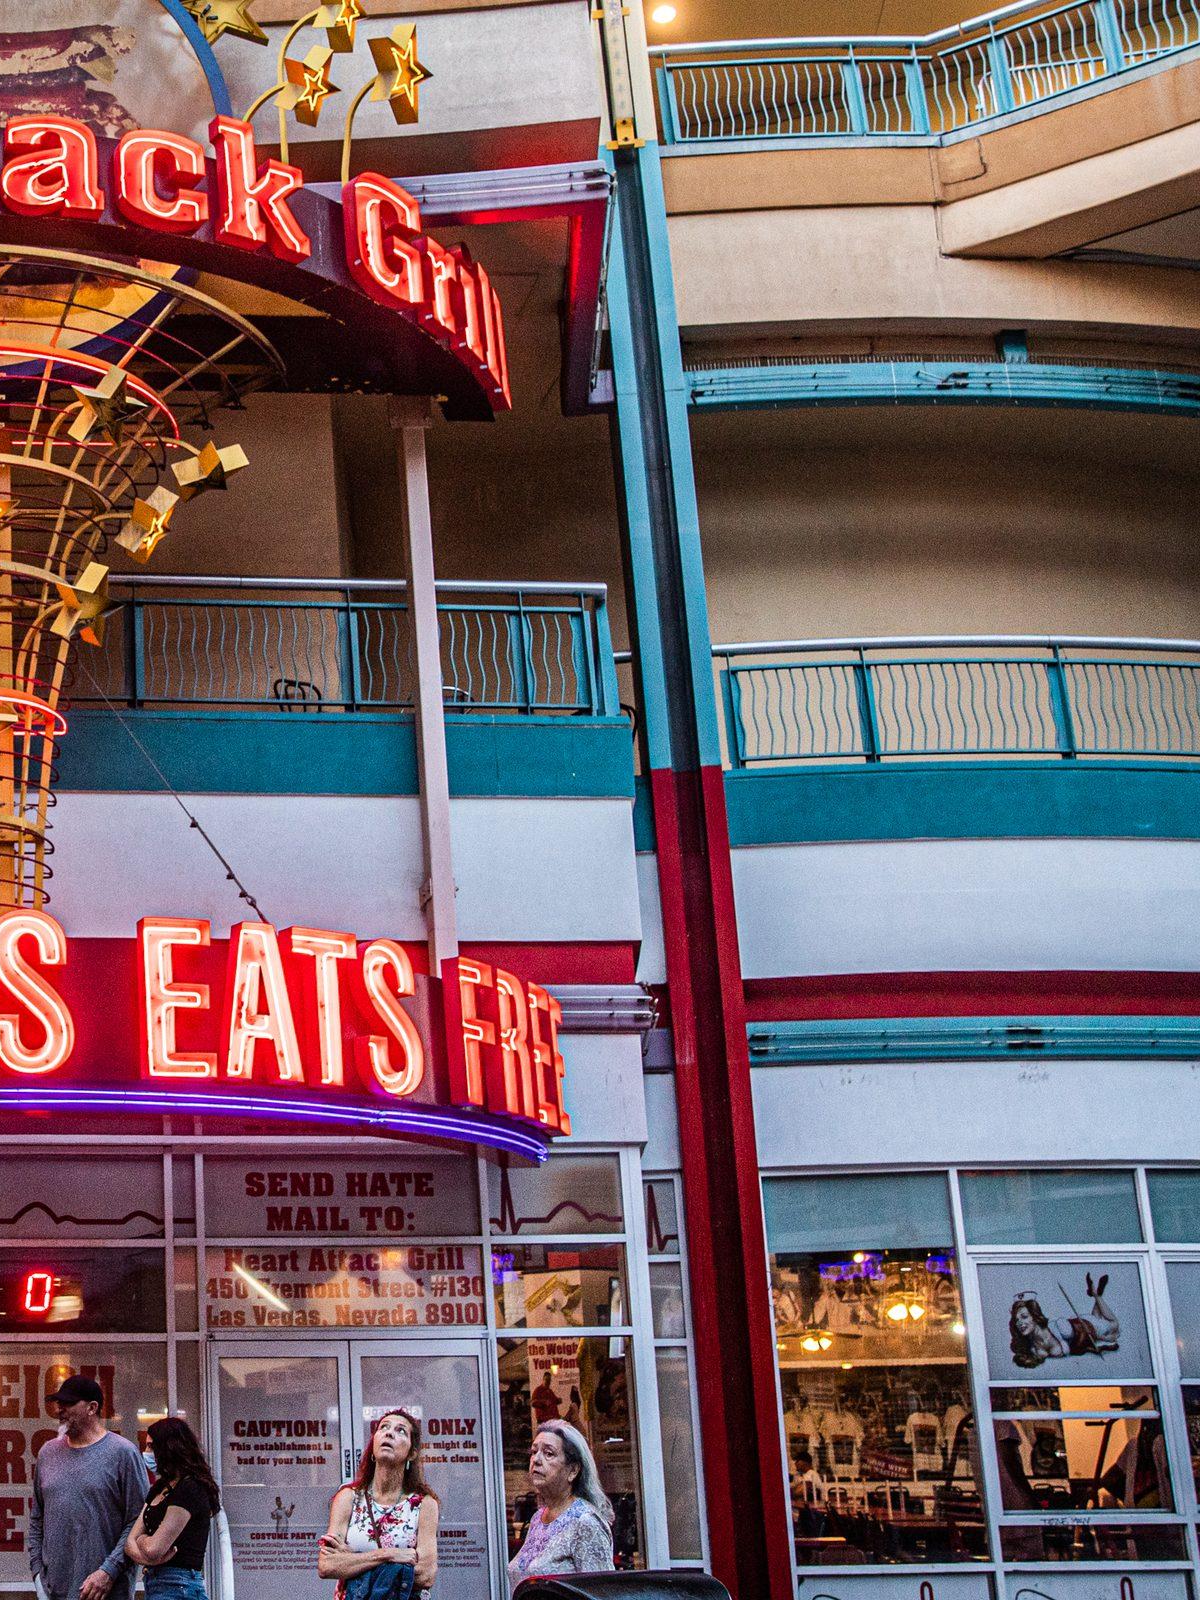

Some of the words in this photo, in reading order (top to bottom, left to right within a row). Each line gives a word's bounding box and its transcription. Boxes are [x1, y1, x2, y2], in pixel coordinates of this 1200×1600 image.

[341, 171, 512, 411] Grill
[137, 916, 424, 1096] EATS
[442, 955, 572, 1137] FREE
[245, 1172, 334, 1197] SEND
[346, 1172, 434, 1197] HATE
[266, 1206, 349, 1231] MAIL
[360, 1206, 416, 1231] TO:
[224, 1248, 299, 1272] Heart
[407, 1246, 465, 1271] Grill
[23, 1271, 53, 1313] 0
[206, 1277, 249, 1299] 450
[357, 1276, 425, 1298] Street
[206, 1304, 246, 1326] Las
[335, 1302, 419, 1326] Nevada
[528, 1344, 545, 1355] the
[546, 1343, 578, 1355] Weigh
[233, 1420, 327, 1437] CAUTION!
[427, 1418, 477, 1435] ONLY
[229, 1442, 252, 1451] This
[254, 1441, 322, 1451] establishment
[324, 1442, 333, 1451] is
[433, 1441, 460, 1451] might
[463, 1441, 477, 1449] die
[237, 1456, 255, 1465] bad
[257, 1456, 270, 1465] for
[273, 1457, 293, 1467] your
[296, 1456, 326, 1465] health
[450, 1454, 480, 1463] clears
[250, 1532, 288, 1540] COSTUME
[291, 1532, 317, 1540] PARTY
[440, 1530, 467, 1538] INSIDE
